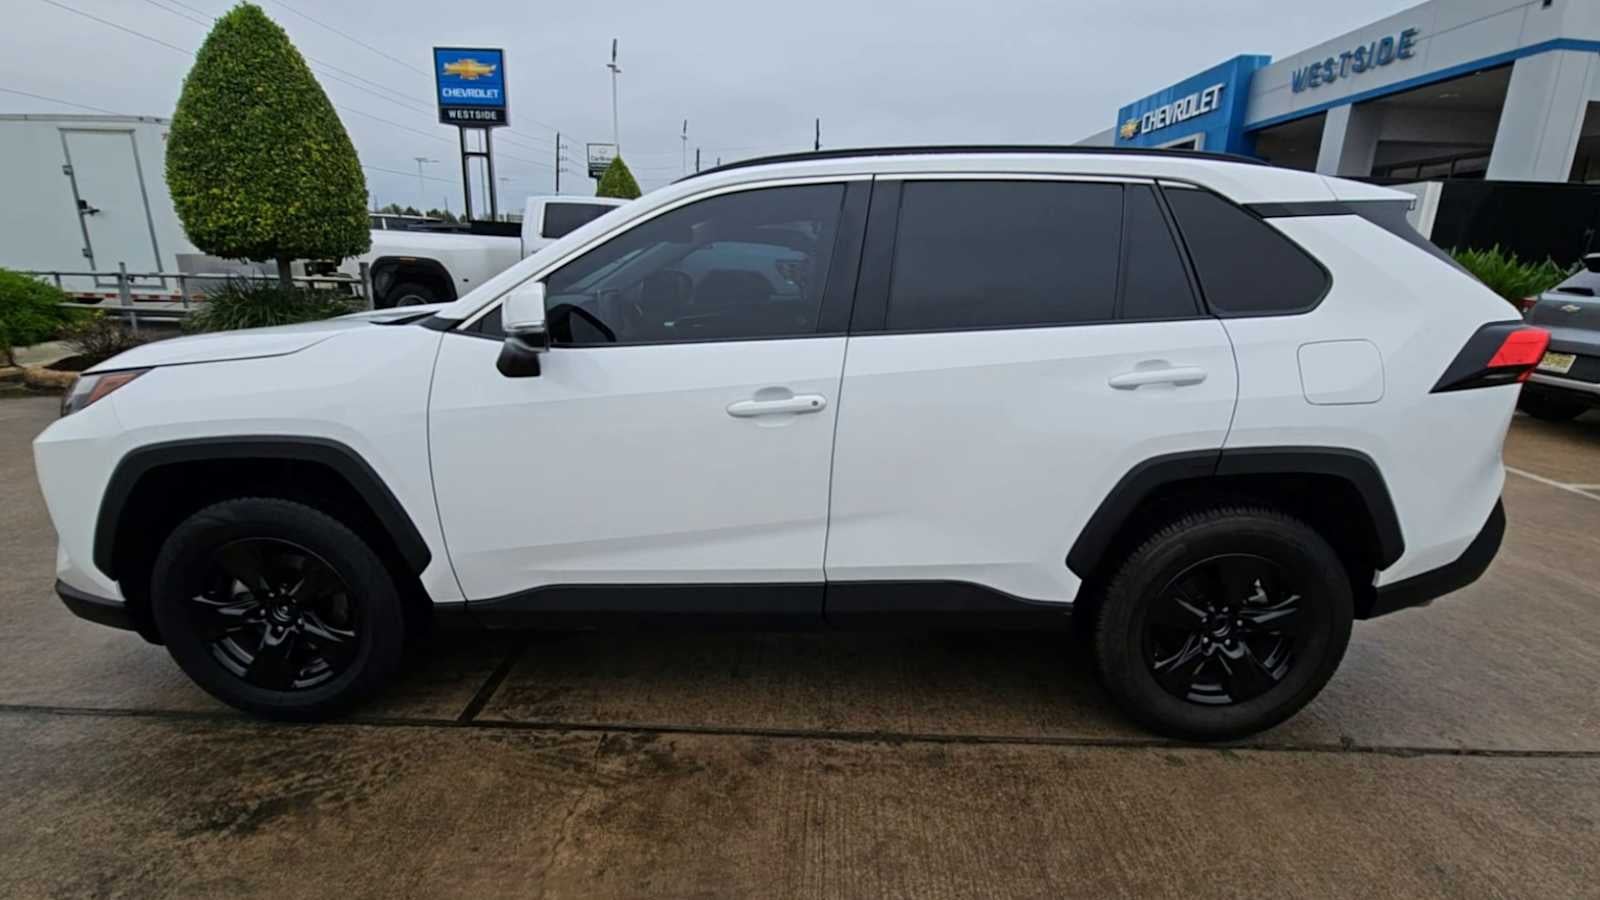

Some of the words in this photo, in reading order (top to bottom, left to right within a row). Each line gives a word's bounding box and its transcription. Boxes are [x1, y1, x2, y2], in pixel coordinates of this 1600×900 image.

[1291, 28, 1418, 93] WESTSIDE
[442, 88, 499, 98] CHEVROLET
[1141, 83, 1225, 133] CHEVROLET
[448, 110, 497, 120] WESTSIDE
